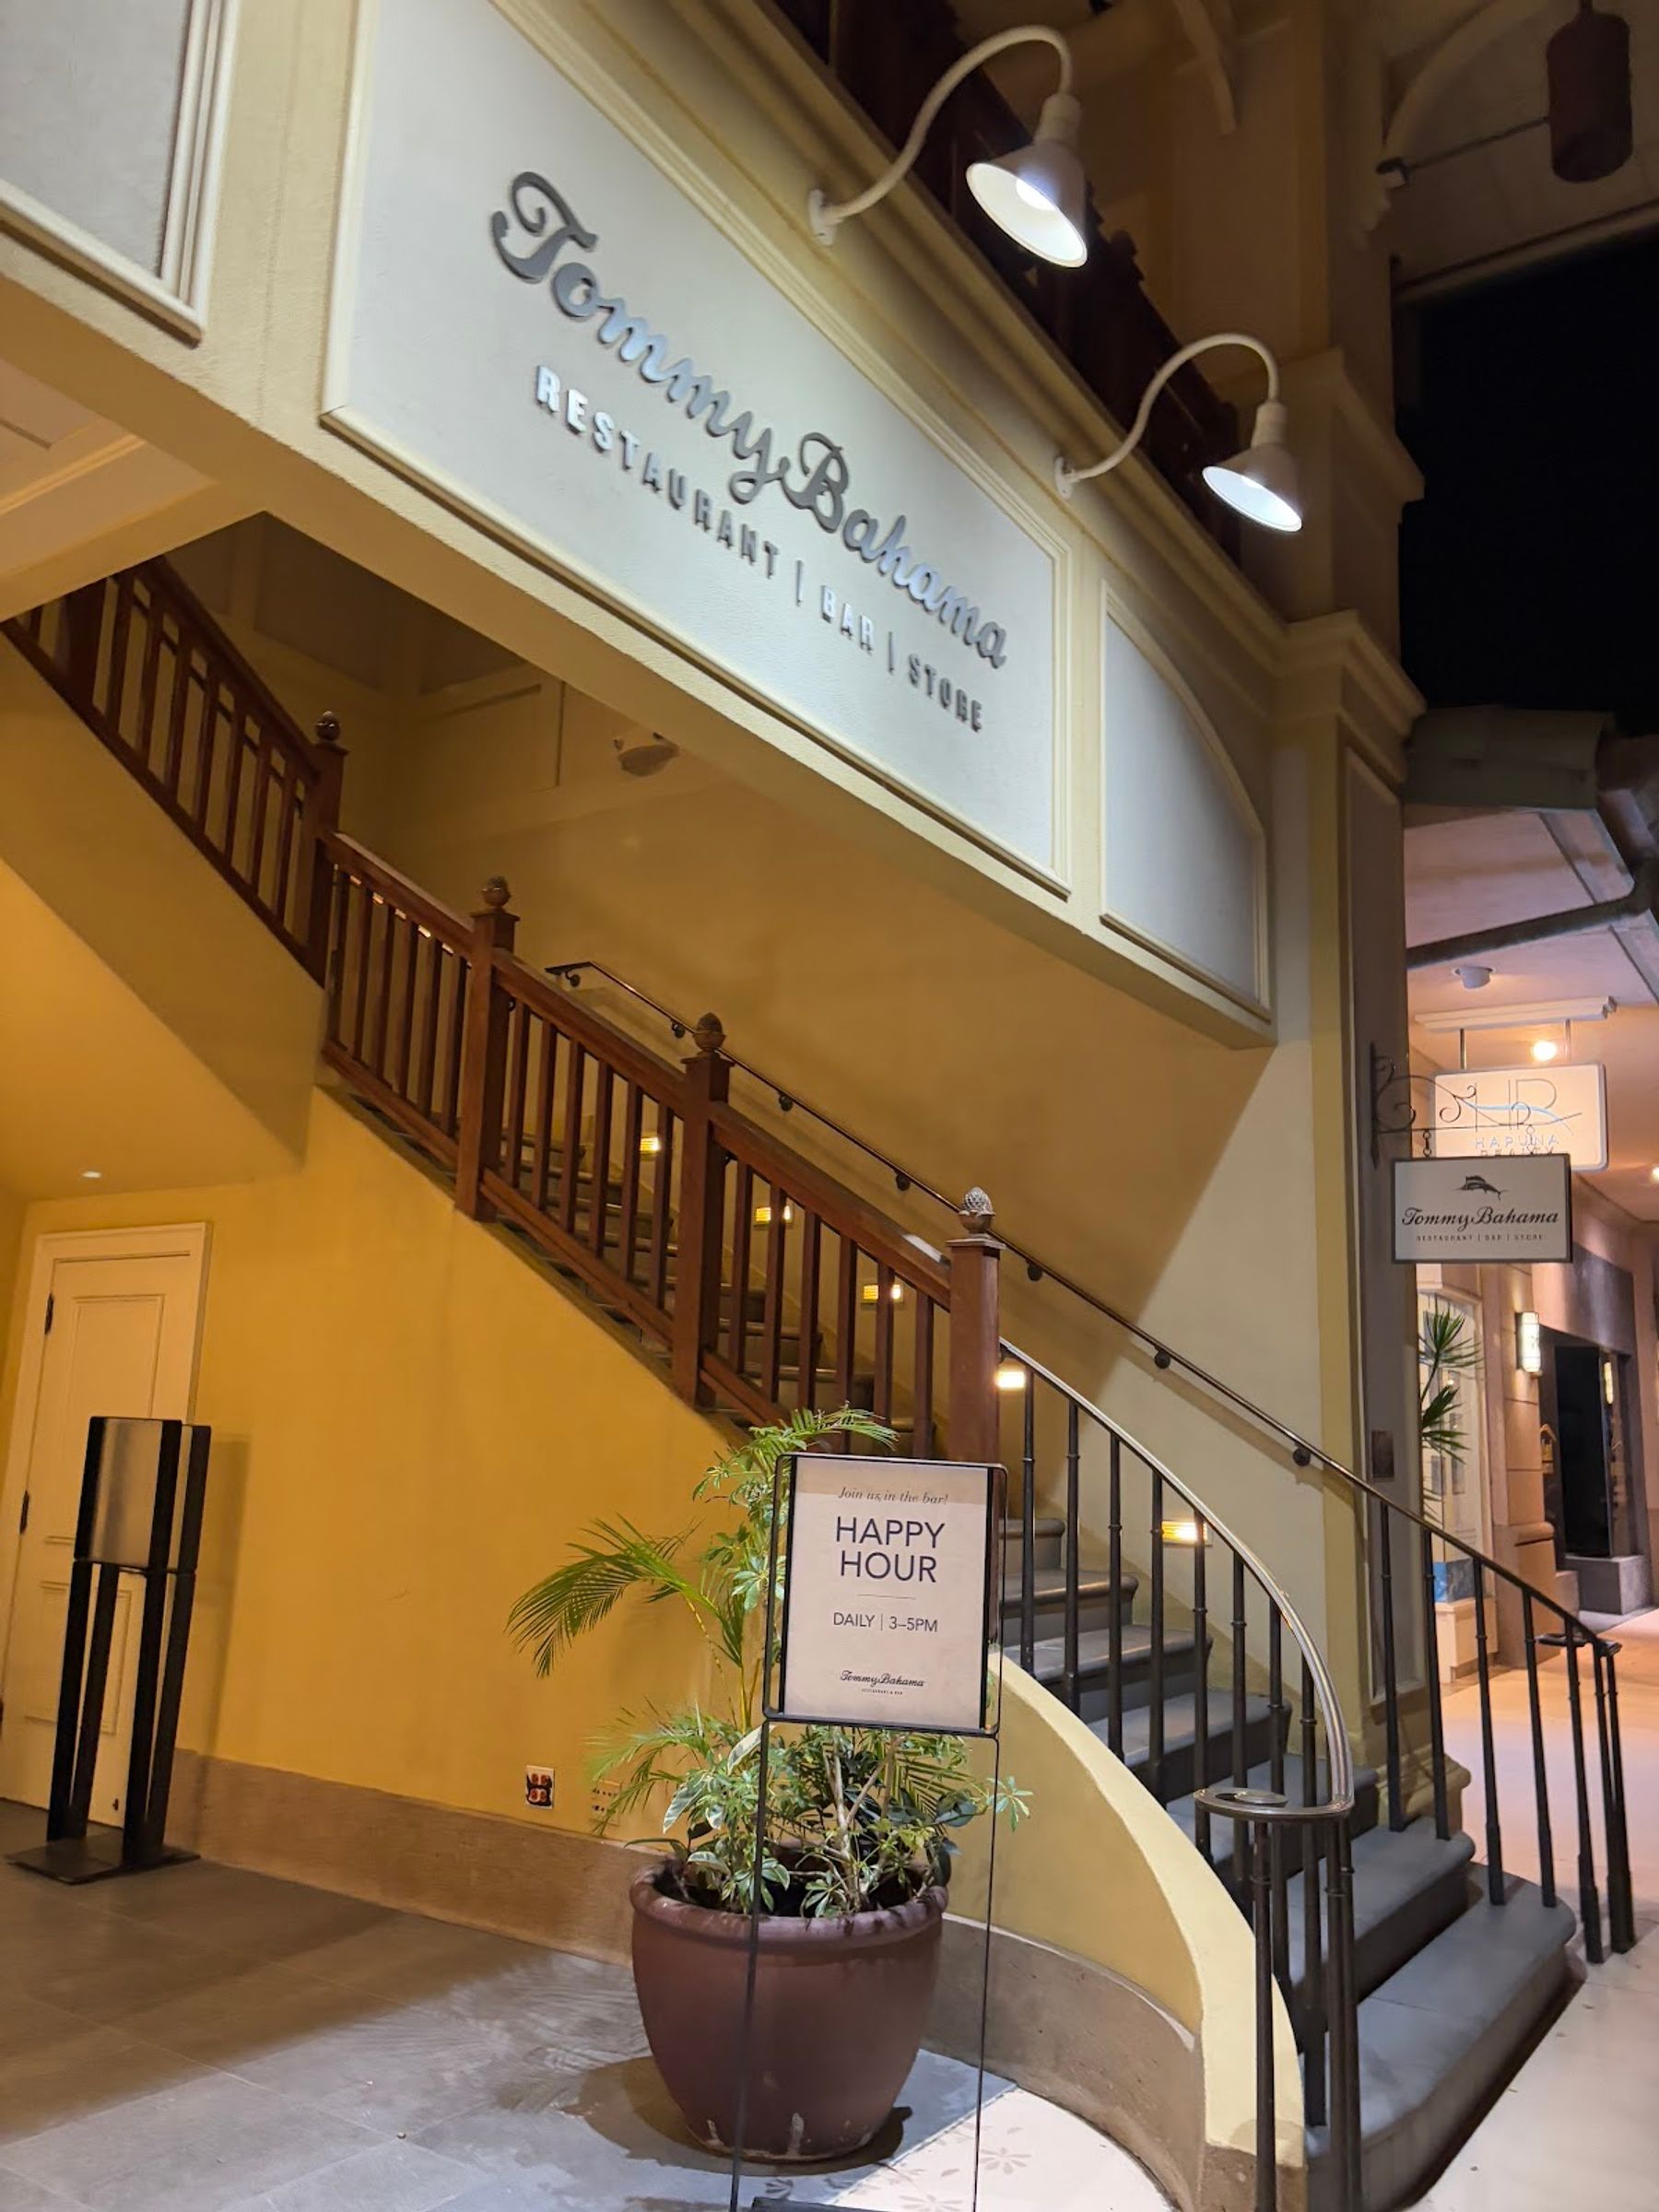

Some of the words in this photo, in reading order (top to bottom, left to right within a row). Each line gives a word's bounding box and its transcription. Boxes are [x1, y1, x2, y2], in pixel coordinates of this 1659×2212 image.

[491, 171, 775, 504] Tommy
[776, 431, 1007, 669] Bahama
[535, 365, 781, 581] RESTAURANT
[820, 583, 876, 653] BAR
[908, 653, 984, 734] STORE
[1476, 1135, 1559, 1148] HAPUNA
[1402, 1206, 1470, 1232] Tommy
[1471, 1206, 1559, 1225] Bahama
[838, 1487, 863, 1499] Join
[883, 1490, 896, 1501] in
[900, 1490, 919, 1502] the
[922, 1492, 948, 1505] bar!
[836, 1516, 946, 1548] HAPPY
[841, 1550, 937, 1583] HOUR
[833, 1612, 876, 1629] DAILY
[840, 1669, 879, 1688] Tommy
[879, 1673, 925, 1687] Bahama
